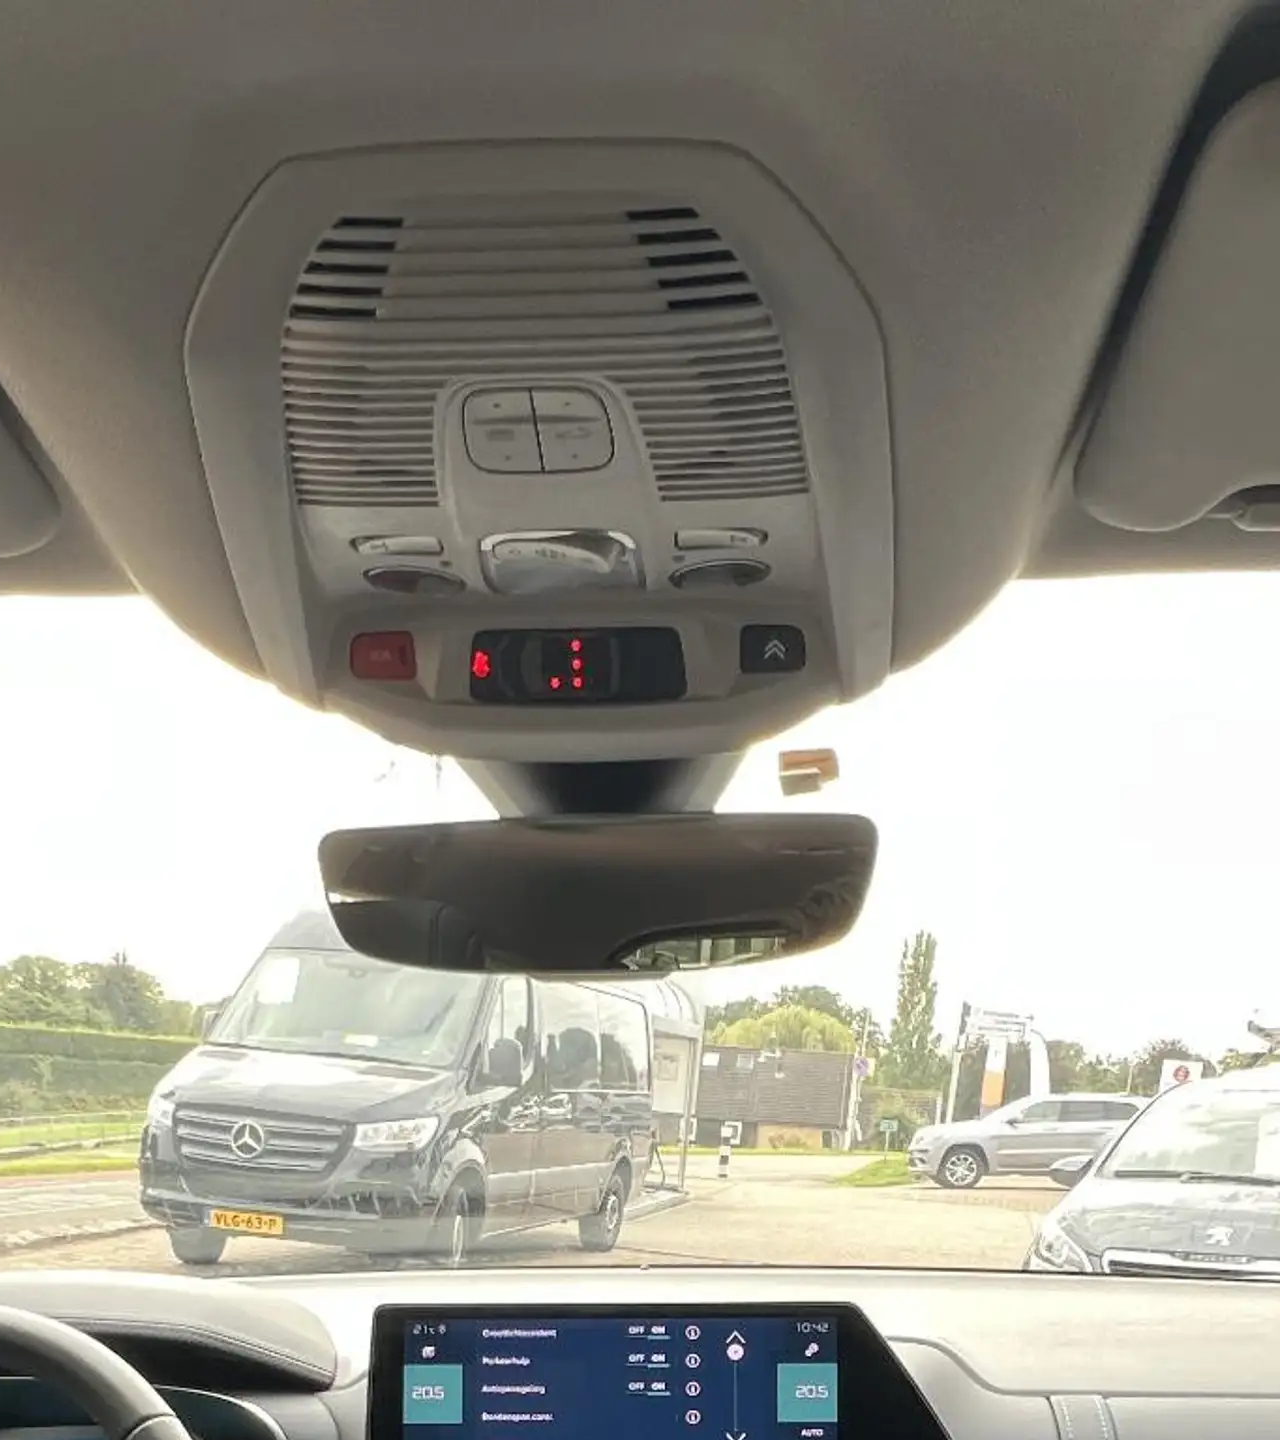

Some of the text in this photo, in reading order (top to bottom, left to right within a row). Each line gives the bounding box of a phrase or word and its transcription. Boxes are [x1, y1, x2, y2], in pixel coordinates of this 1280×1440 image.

[628, 1326, 666, 1335] OFF ON
[628, 1354, 666, 1363] OFF ON
[628, 1382, 666, 1391] OFF ON
[801, 1429, 824, 1437] AUTO
